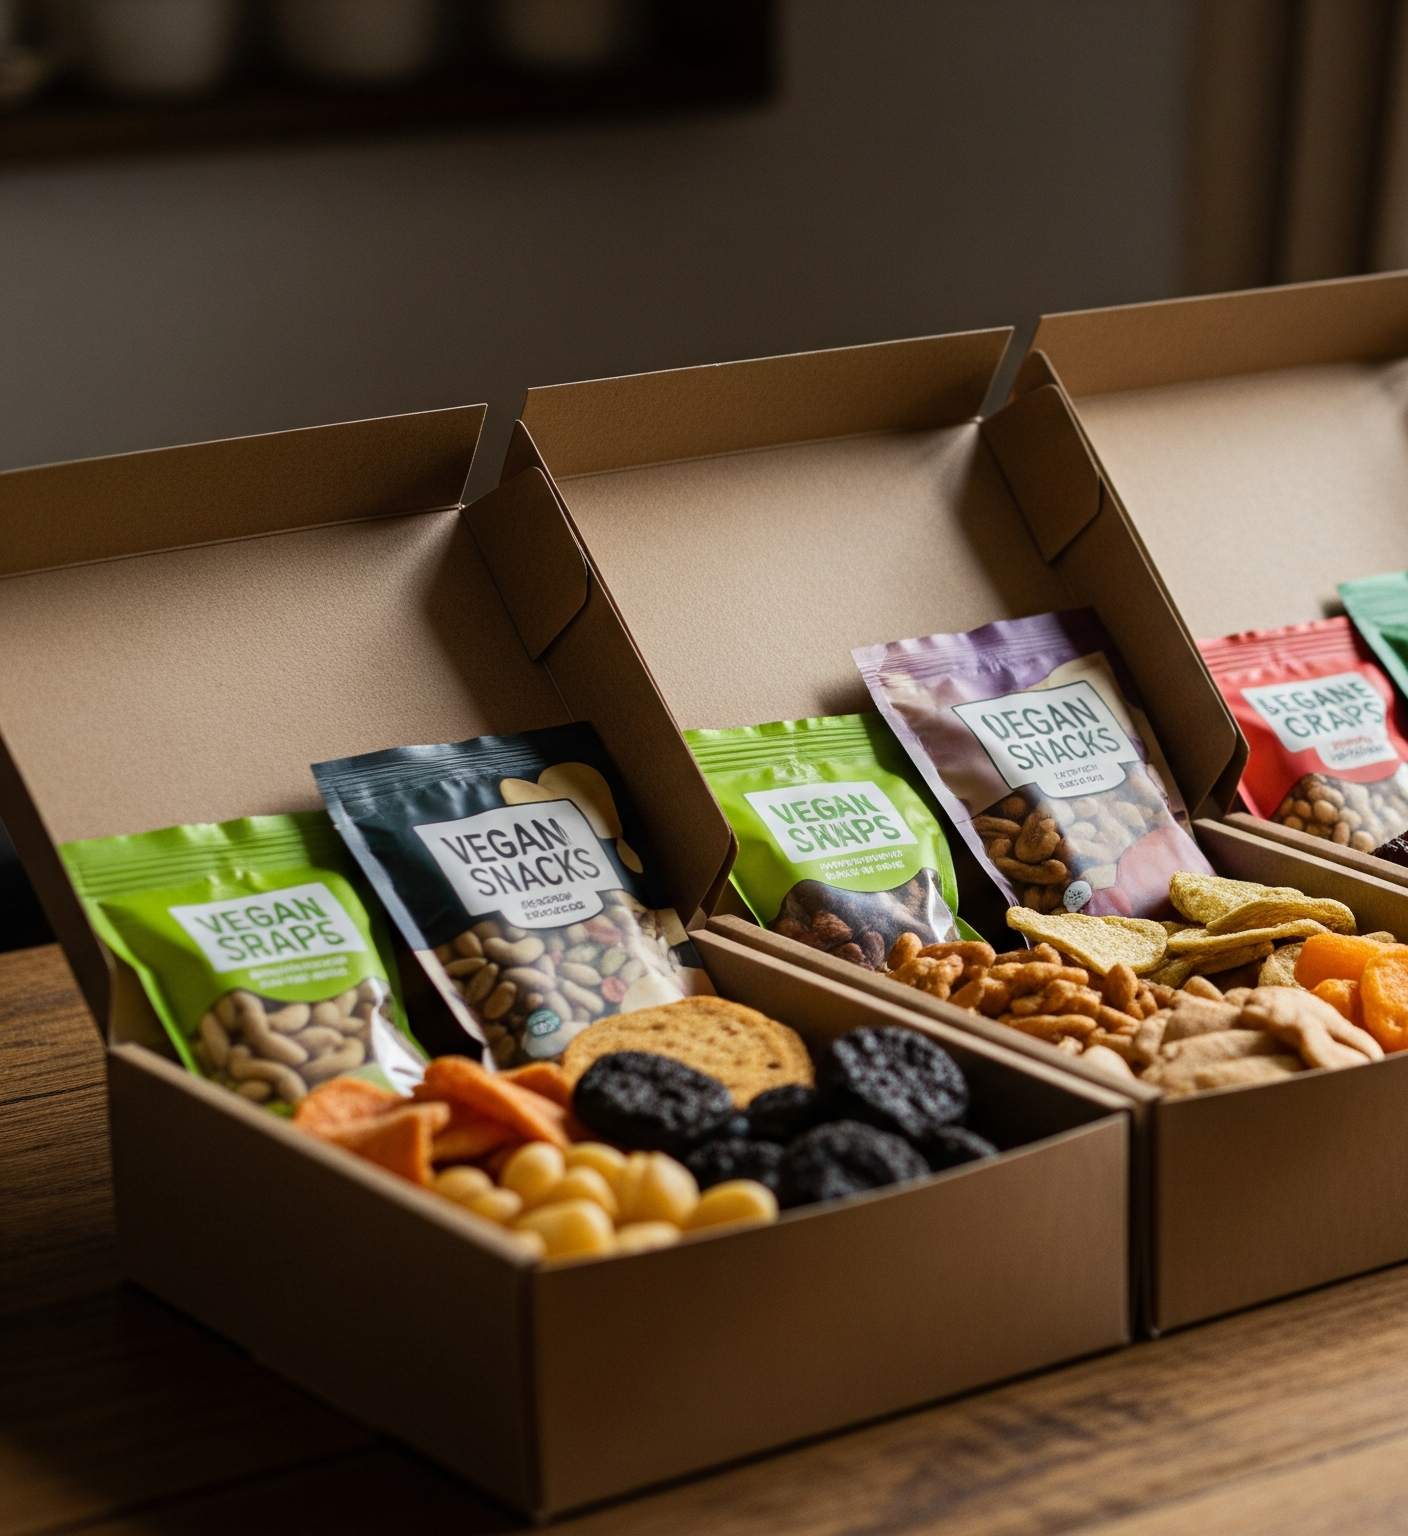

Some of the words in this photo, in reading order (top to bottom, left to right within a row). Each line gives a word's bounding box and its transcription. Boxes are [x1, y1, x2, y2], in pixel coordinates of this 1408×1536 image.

[1007, 727, 1121, 771] SNACKS
[768, 793, 881, 825] VEGAN
[440, 817, 573, 864] VEGAN
[470, 847, 601, 896] SNACKS
[194, 897, 328, 935] VEGAN
